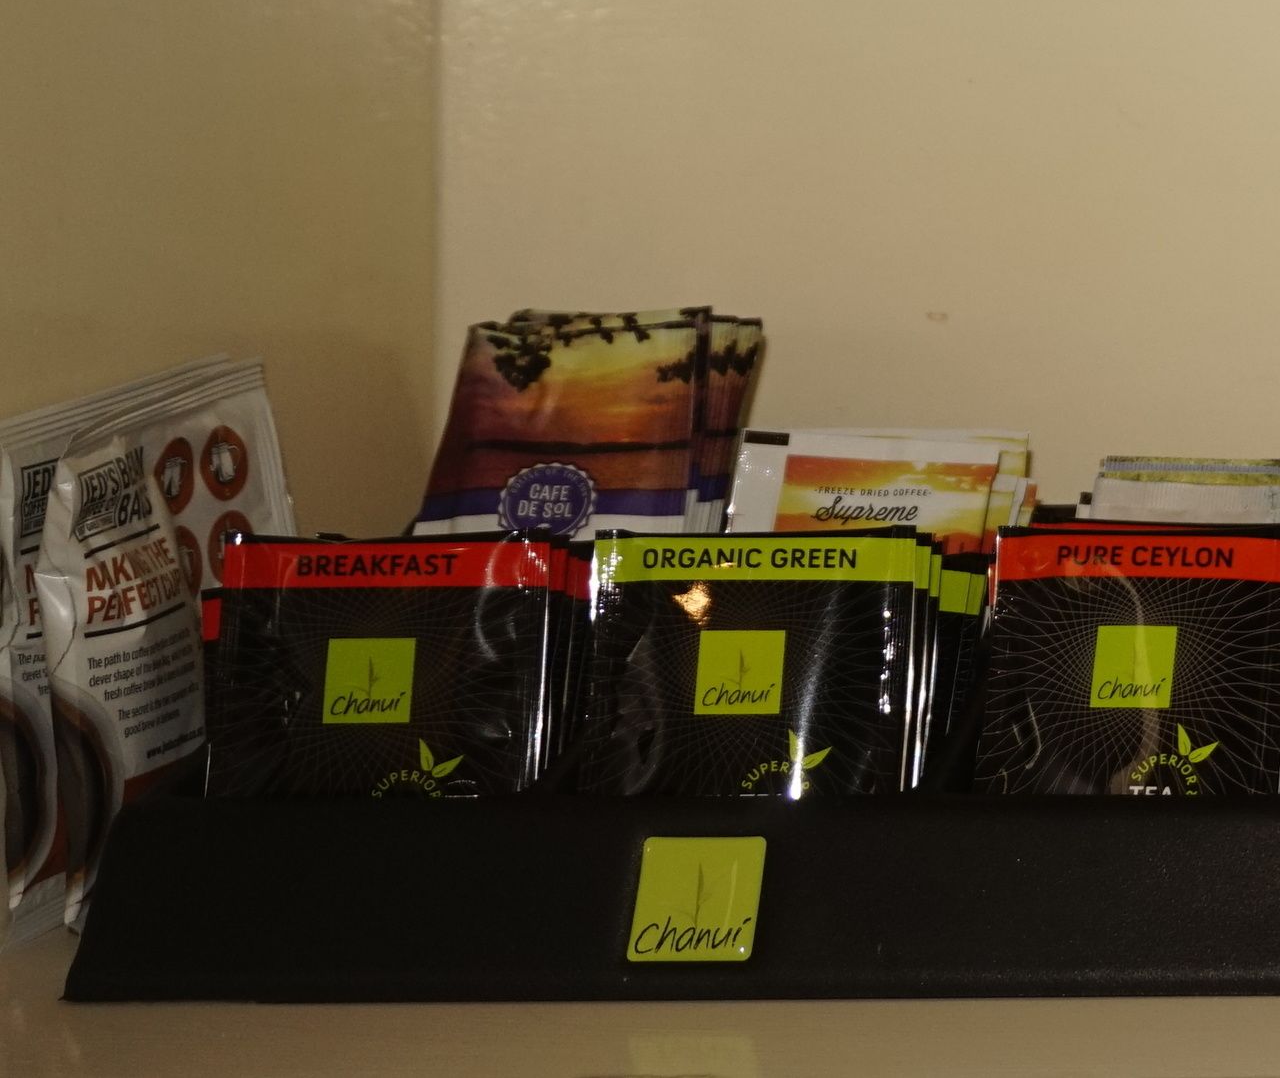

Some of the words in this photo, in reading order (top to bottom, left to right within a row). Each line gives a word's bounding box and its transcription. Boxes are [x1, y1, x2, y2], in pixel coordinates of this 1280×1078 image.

[84, 466, 119, 506] JED'S
[529, 483, 571, 502] CAFE
[860, 488, 890, 497] DRIED
[517, 499, 540, 517] DE
[811, 495, 919, 526] Supreme
[296, 553, 459, 577] BREAKFAST
[642, 547, 762, 570] ORGANIC
[770, 548, 858, 569] GREEN
[1056, 544, 1124, 567] PURE
[1131, 546, 1235, 568] CEYLON
[17, 653, 32, 665] The
[88, 657, 103, 670] The
[104, 652, 122, 669] path
[123, 651, 131, 663] to
[89, 673, 112, 687] clever
[113, 667, 135, 682] shape
[1096, 677, 1166, 700] Chanui
[104, 687, 122, 702] fresh
[123, 683, 144, 697] coffee
[329, 691, 407, 717] Chanui
[701, 682, 776, 707] Chanui
[118, 708, 131, 721] The
[124, 724, 142, 738] good
[1131, 753, 1198, 786] SUPERIOR
[371, 769, 443, 799] SUPERIOR
[634, 915, 752, 954] Chanui
